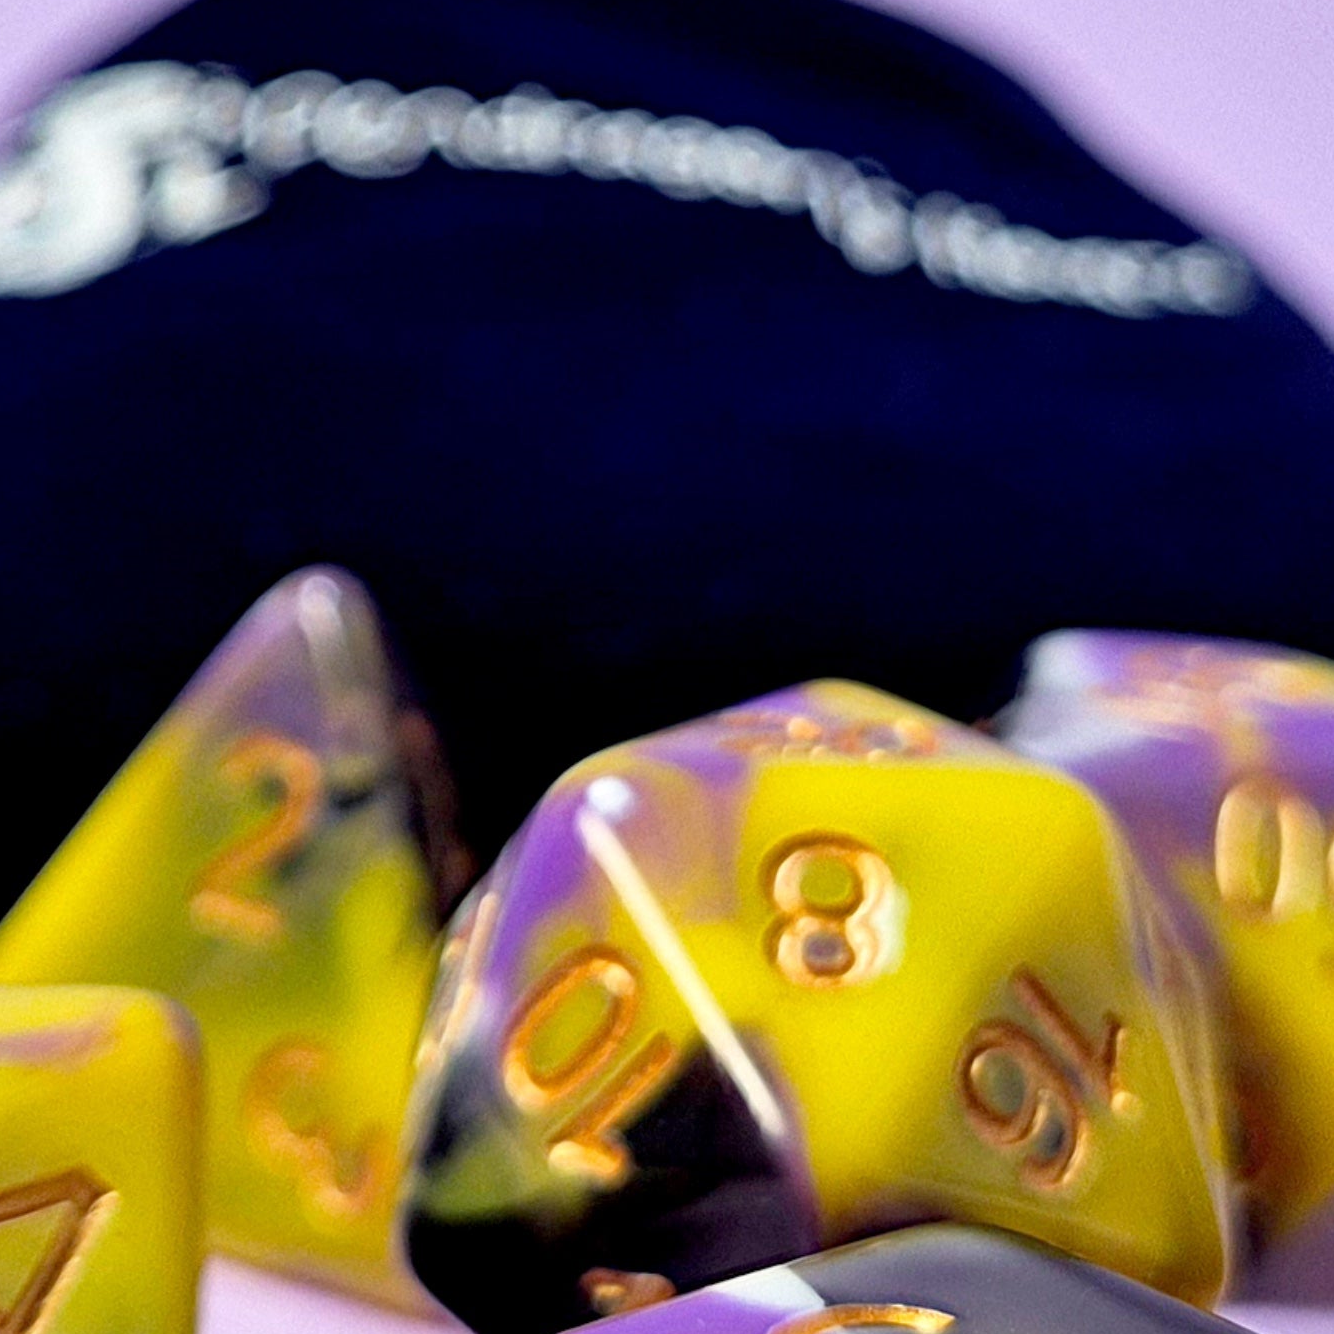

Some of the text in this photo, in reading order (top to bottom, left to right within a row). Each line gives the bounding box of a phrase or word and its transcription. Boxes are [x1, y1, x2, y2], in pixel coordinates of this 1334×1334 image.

[187, 733, 322, 942] 2
[759, 829, 905, 988] 8
[500, 942, 679, 1185] 10
[958, 964, 1140, 1191] 16
